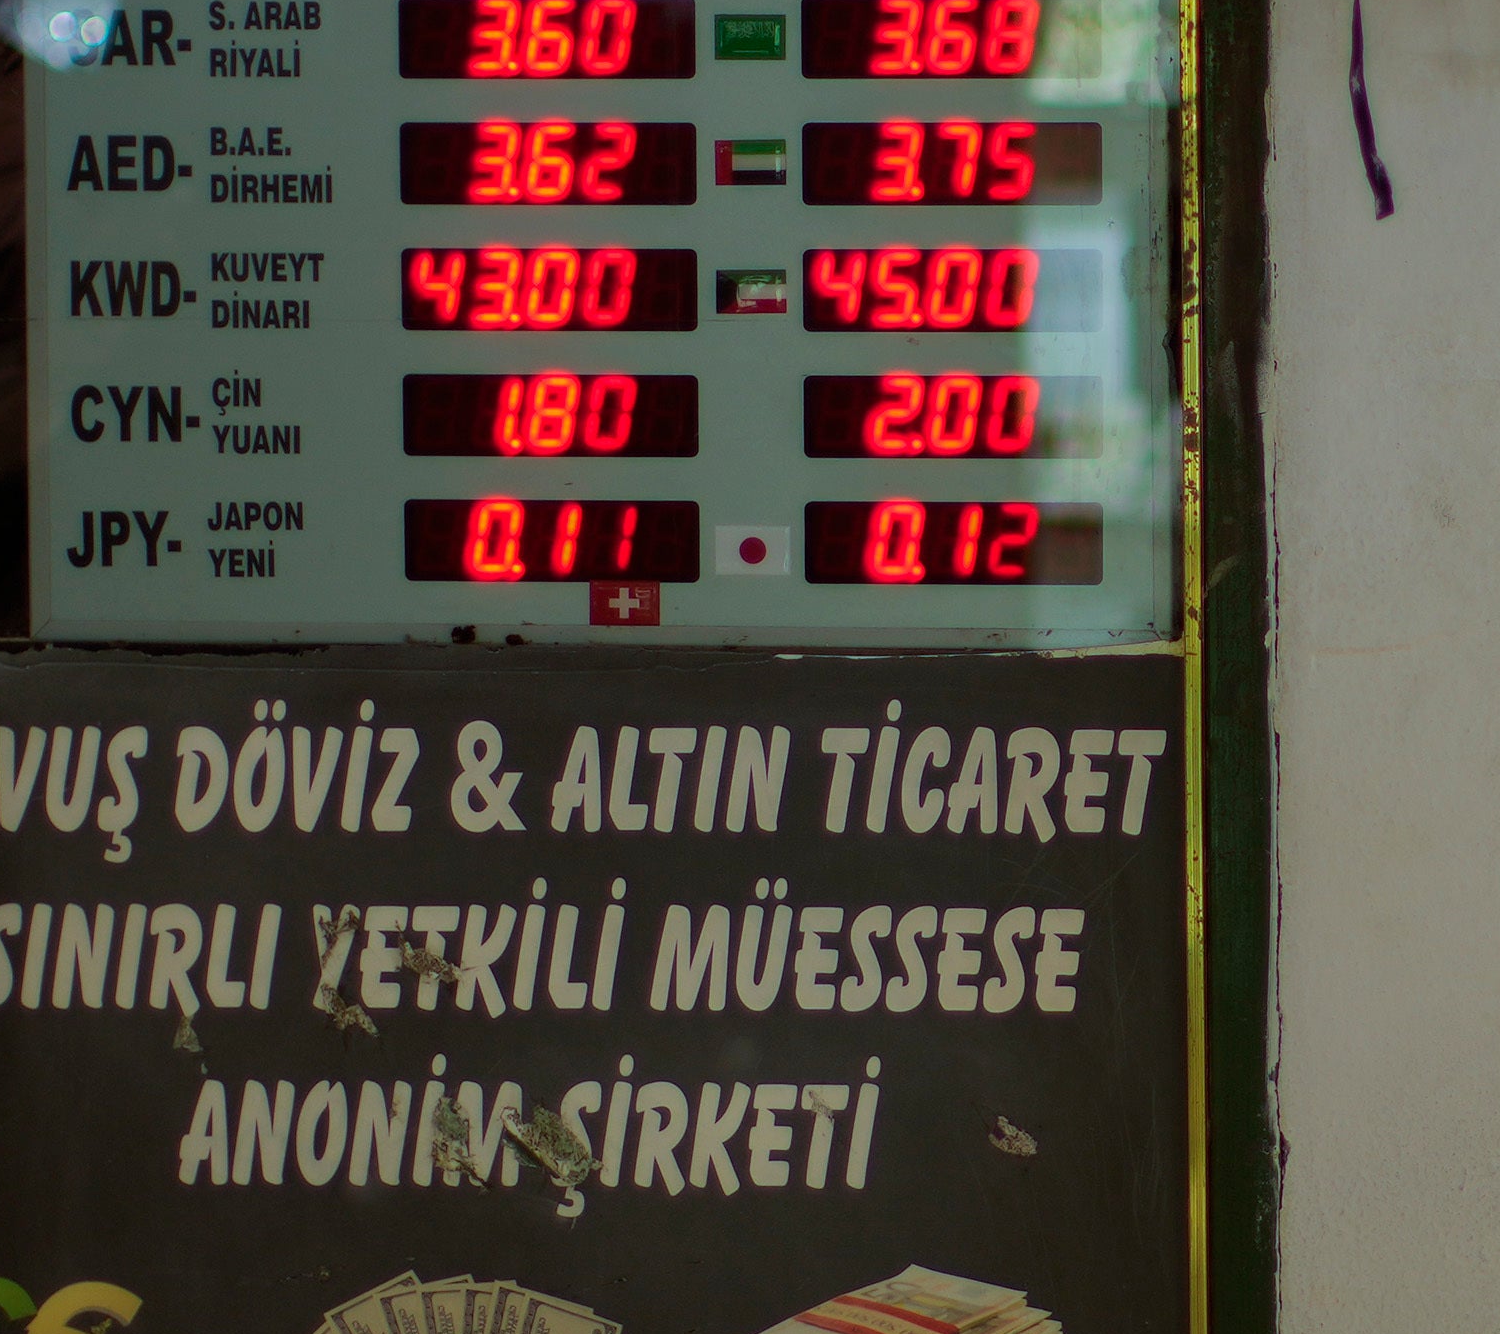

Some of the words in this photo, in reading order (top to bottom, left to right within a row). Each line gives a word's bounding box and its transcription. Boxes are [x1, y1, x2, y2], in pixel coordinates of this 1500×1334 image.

[209, 2, 235, 32] S.
[243, 1, 322, 32] ARAB
[209, 40, 301, 79] RİYALİ
[209, 128, 292, 158] B.A.E.
[67, 136, 192, 191] AED-
[209, 166, 333, 204] DİRHEMİ
[210, 254, 324, 284] KUVEYT
[70, 261, 196, 318] KWD-
[211, 292, 309, 330] DİNARI
[71, 386, 200, 442] CYN-
[212, 376, 262, 414] ÇİN
[212, 425, 301, 455] YUANI
[208, 502, 305, 532] JAPON
[67, 512, 181, 569] JPY-
[209, 540, 276, 578] YENİ
[174, 700, 417, 835] DÖVİZ
[452, 722, 526, 831] &
[551, 723, 791, 835] ALTIN
[821, 699, 1166, 846] TİCARET
[650, 879, 1086, 1013] MÜESSESE
[179, 1054, 519, 1188] ANONİM
